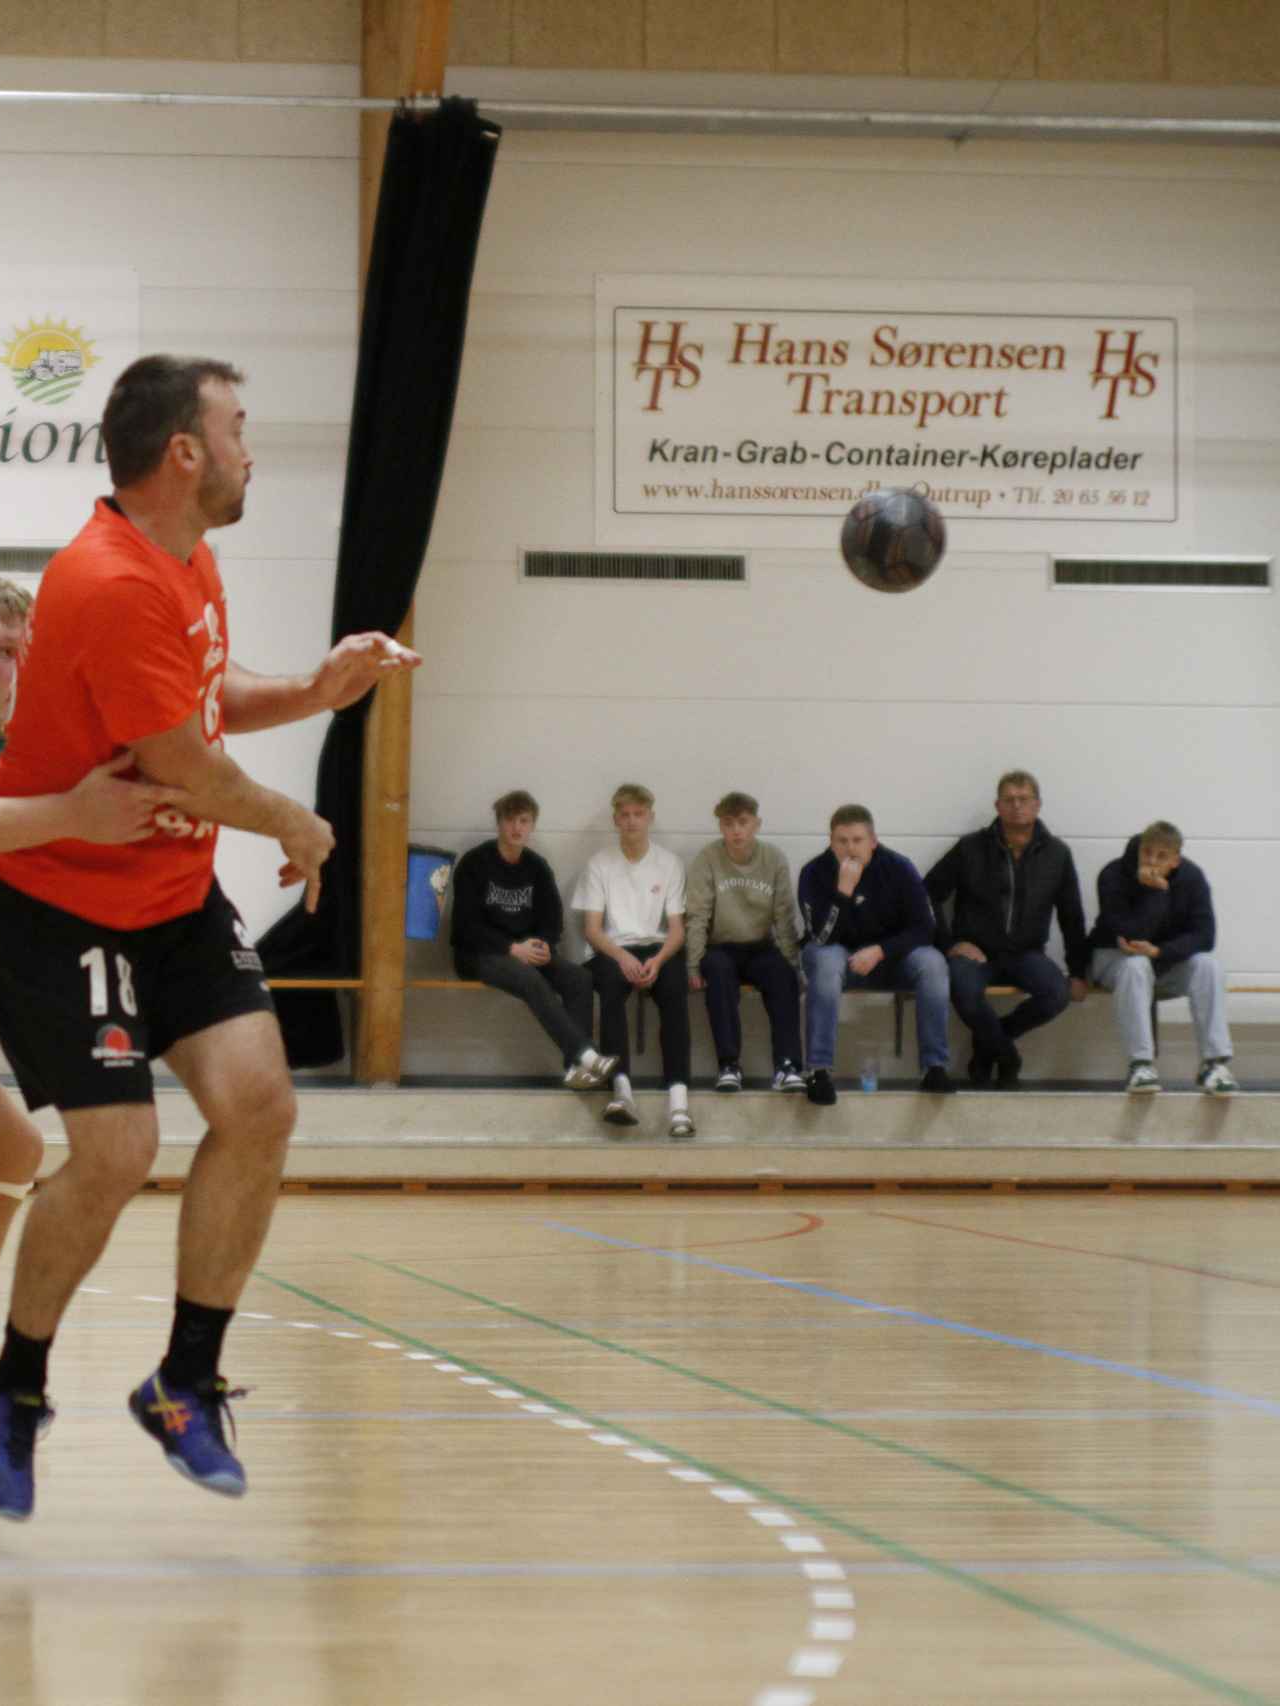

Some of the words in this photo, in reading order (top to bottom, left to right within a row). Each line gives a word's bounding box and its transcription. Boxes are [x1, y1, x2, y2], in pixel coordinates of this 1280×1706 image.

[727, 322, 849, 366] Hans
[869, 325, 1066, 371] Sørensen
[786, 372, 1008, 429] Transport
[79, 947, 138, 1017] 18
